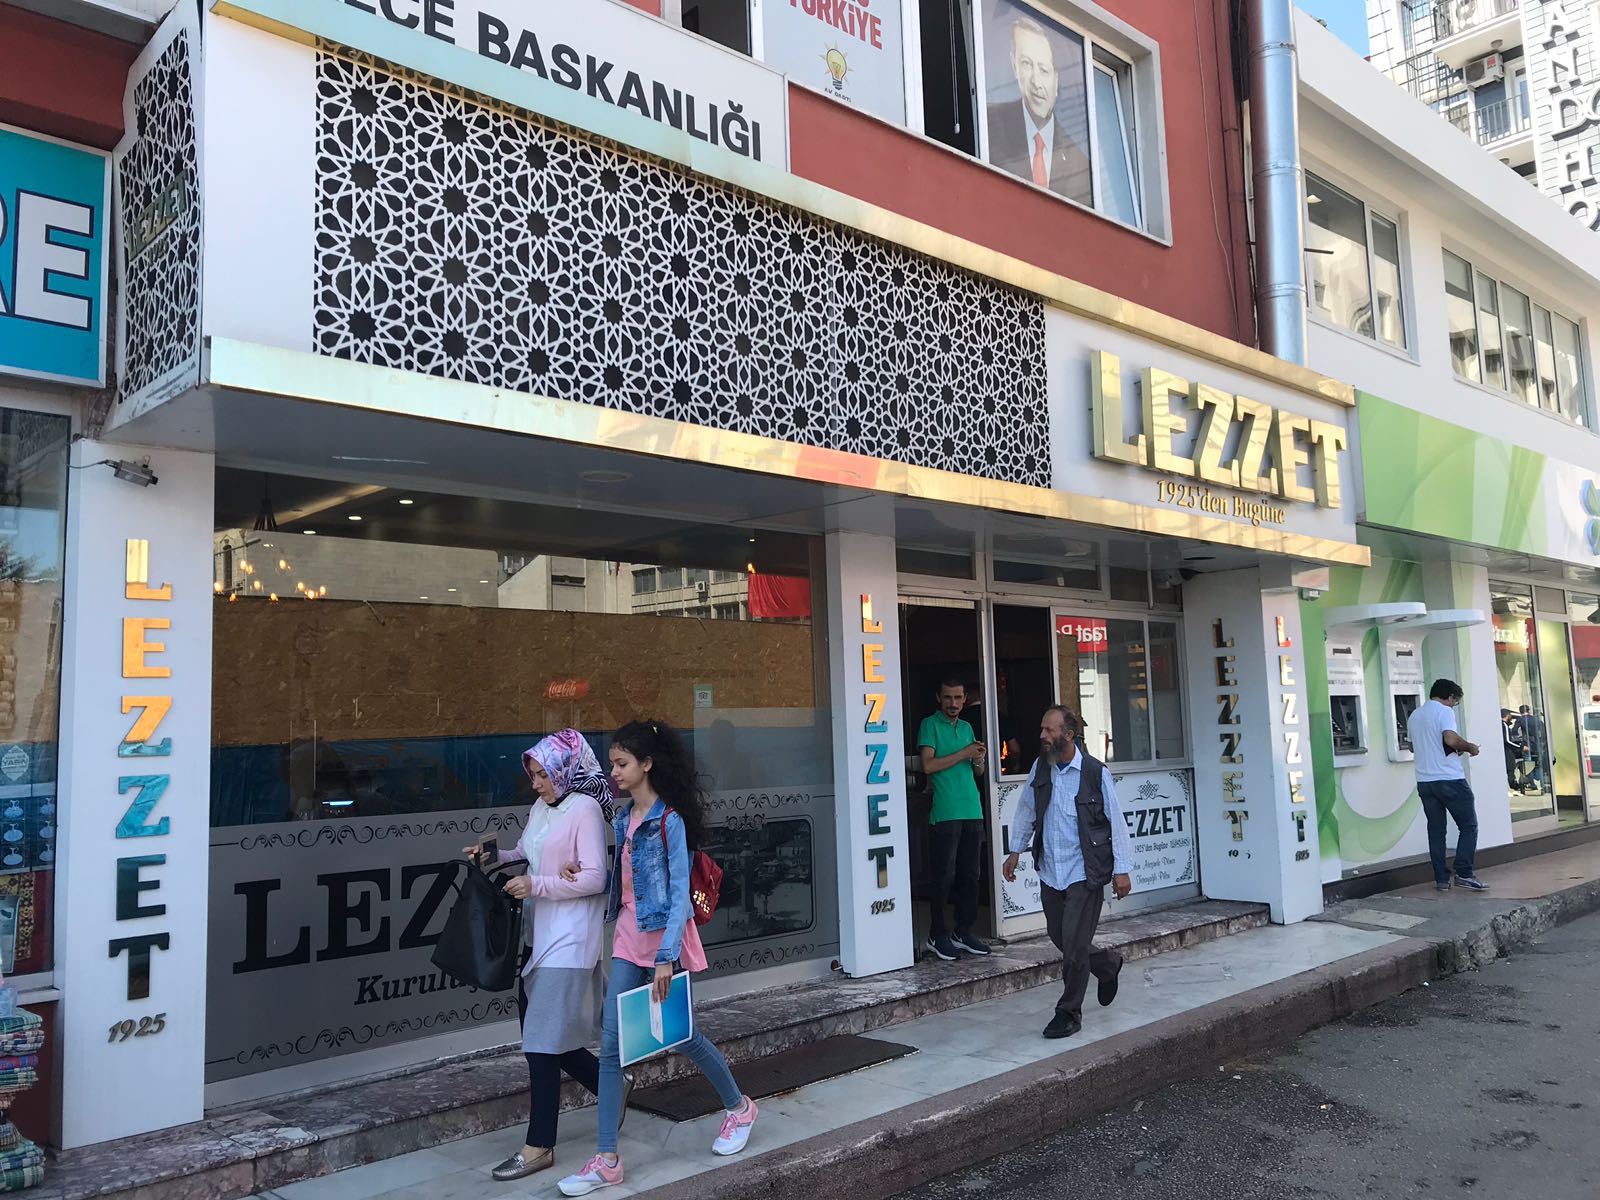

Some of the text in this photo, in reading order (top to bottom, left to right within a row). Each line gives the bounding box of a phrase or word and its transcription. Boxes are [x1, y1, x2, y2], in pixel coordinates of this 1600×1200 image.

[0, 187, 95, 332] E
[1091, 350, 1347, 509] LEZZET
[1157, 480, 1286, 526] 1925'den Bugüne
[108, 538, 173, 1001] LEZZET
[861, 594, 895, 889] LEZZET
[1212, 617, 1249, 842] LEZZET
[1275, 615, 1308, 843] LEZZET
[1122, 804, 1187, 839] EZZET
[233, 861, 460, 975] LEZ
[870, 898, 896, 915] 1925
[107, 1013, 167, 1043] 1925
